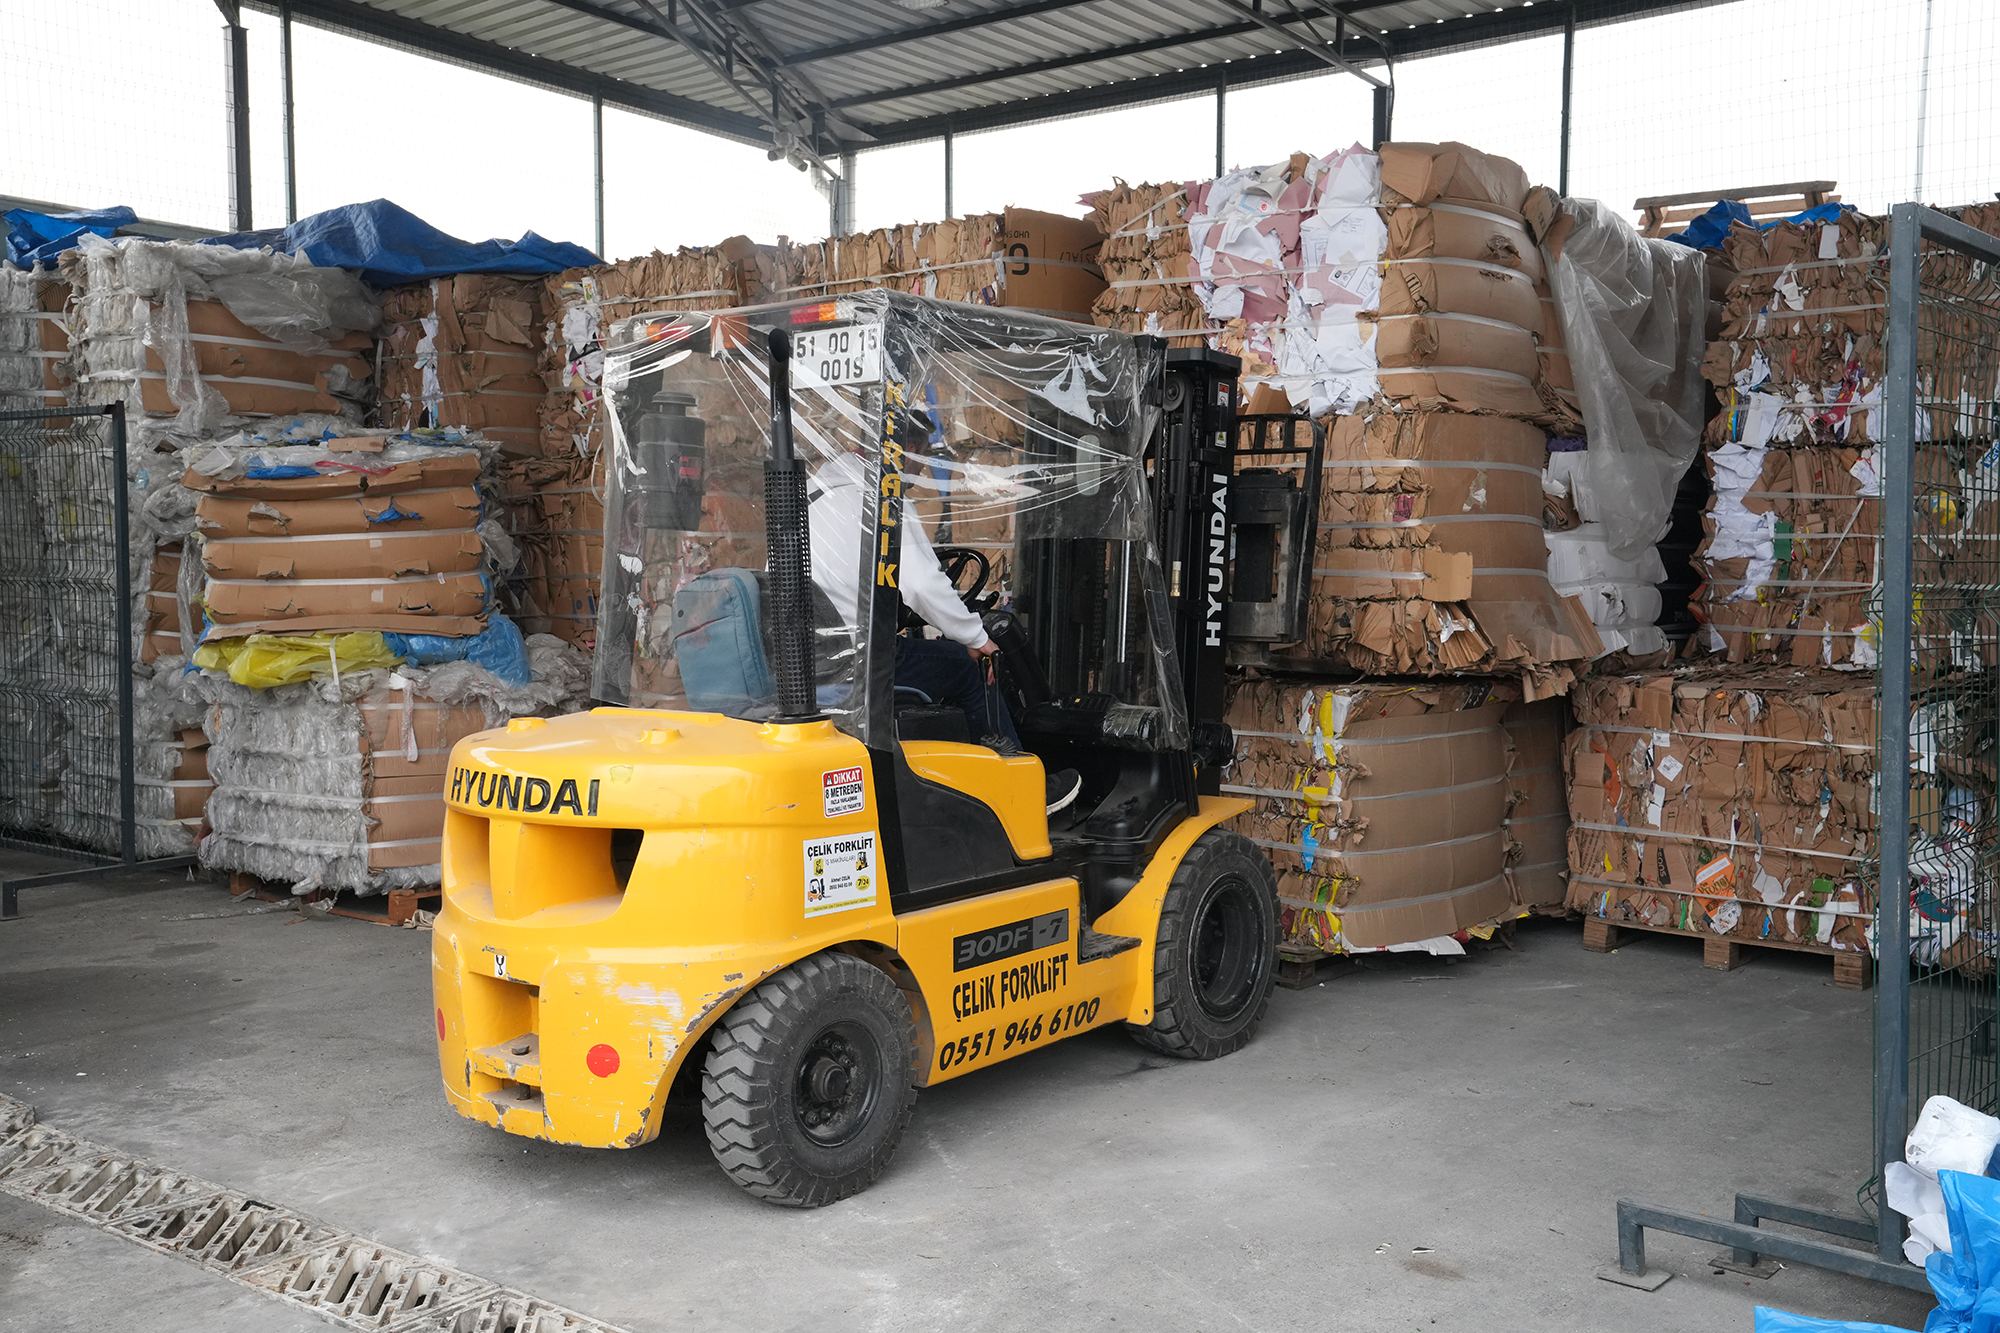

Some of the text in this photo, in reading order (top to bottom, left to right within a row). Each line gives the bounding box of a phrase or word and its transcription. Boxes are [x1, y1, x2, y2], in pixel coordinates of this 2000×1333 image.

[796, 335, 815, 358] 51
[828, 331, 849, 355] 00
[877, 380, 906, 588] KIRALIK
[1205, 473, 1228, 647] HYUNDAI
[451, 767, 601, 817] HYUNDAI
[825, 783, 862, 799] 8 METREDEN
[807, 836, 873, 861] ÇELİK FORKLİFT
[939, 997, 1101, 1071] 0551 946 6100
